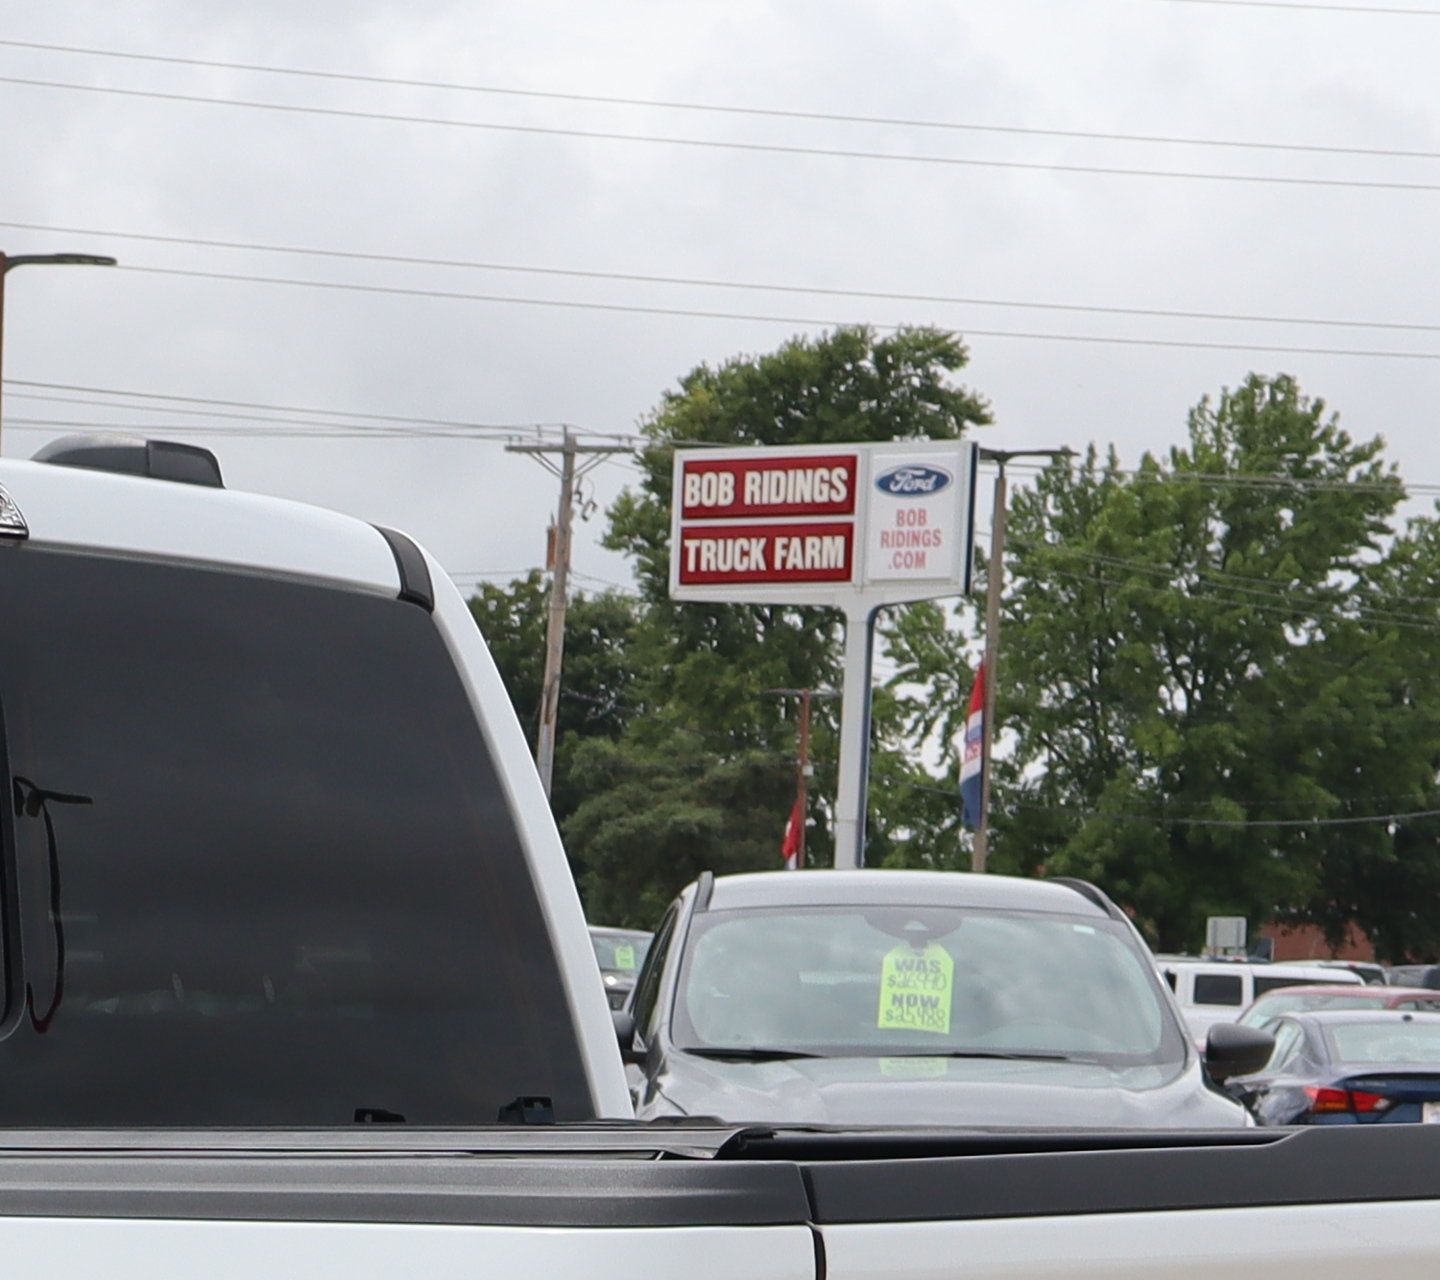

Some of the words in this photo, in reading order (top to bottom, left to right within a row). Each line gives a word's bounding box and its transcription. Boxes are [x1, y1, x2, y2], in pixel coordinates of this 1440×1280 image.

[684, 471, 735, 507] BOB
[744, 467, 848, 505] RIDINGS
[896, 508, 927, 527] BOB
[880, 529, 942, 549] RIDINGS
[684, 537, 767, 572] TRUCK
[774, 535, 846, 570] FARM
[888, 552, 926, 569] .COM
[895, 960, 942, 973] WAS
[891, 994, 941, 1008] NOW
